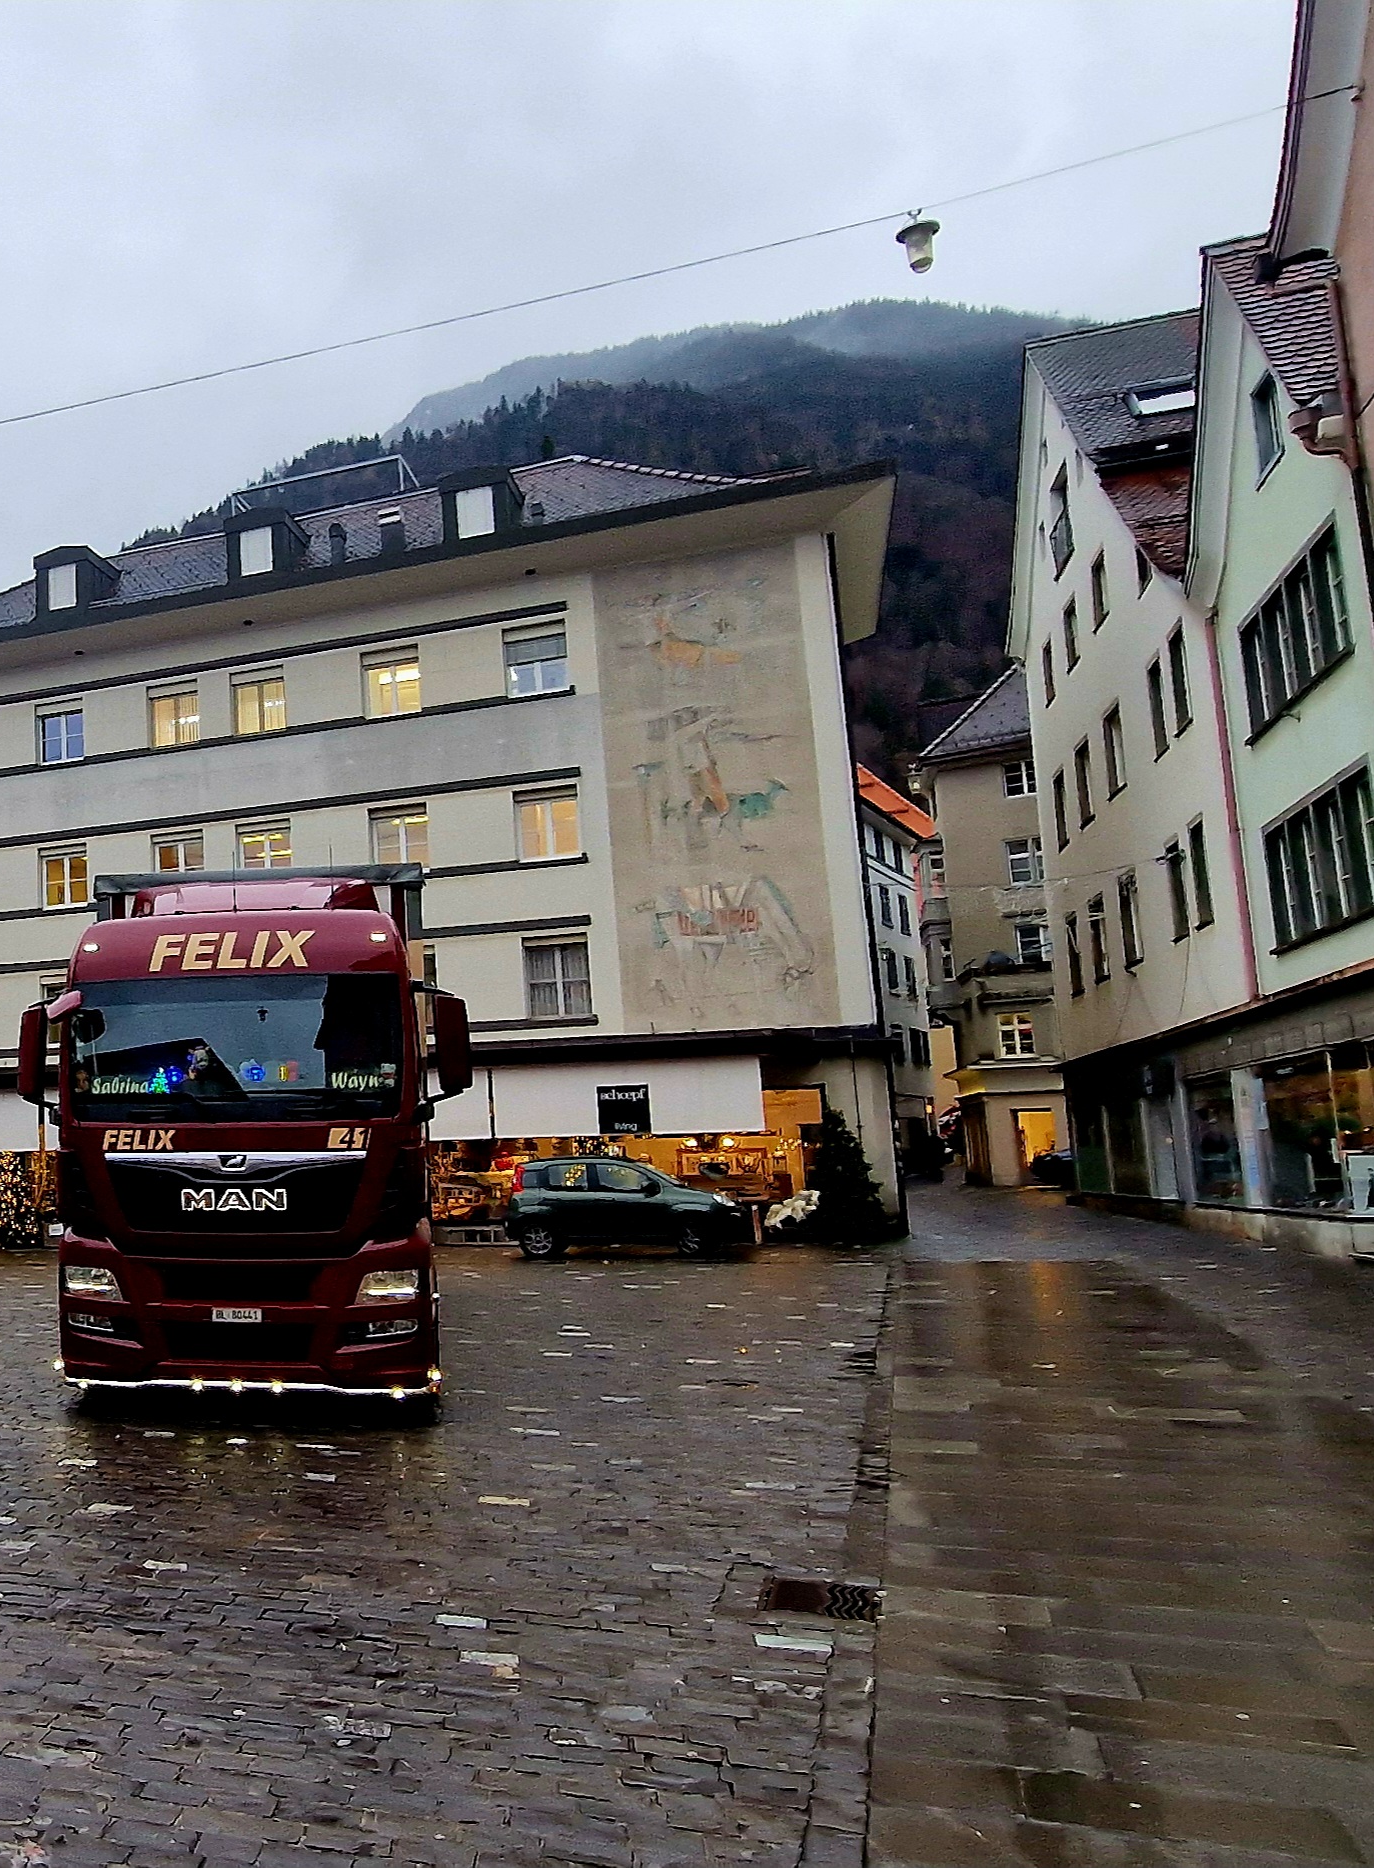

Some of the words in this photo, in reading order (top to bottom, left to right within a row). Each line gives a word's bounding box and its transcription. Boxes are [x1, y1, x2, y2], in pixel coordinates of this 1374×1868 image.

[149, 930, 316, 972] FELIX
[91, 1076, 149, 1094] Sabrina
[102, 1129, 176, 1150] FELIX
[338, 1127, 370, 1149] 41
[181, 1188, 287, 1211] MAN
